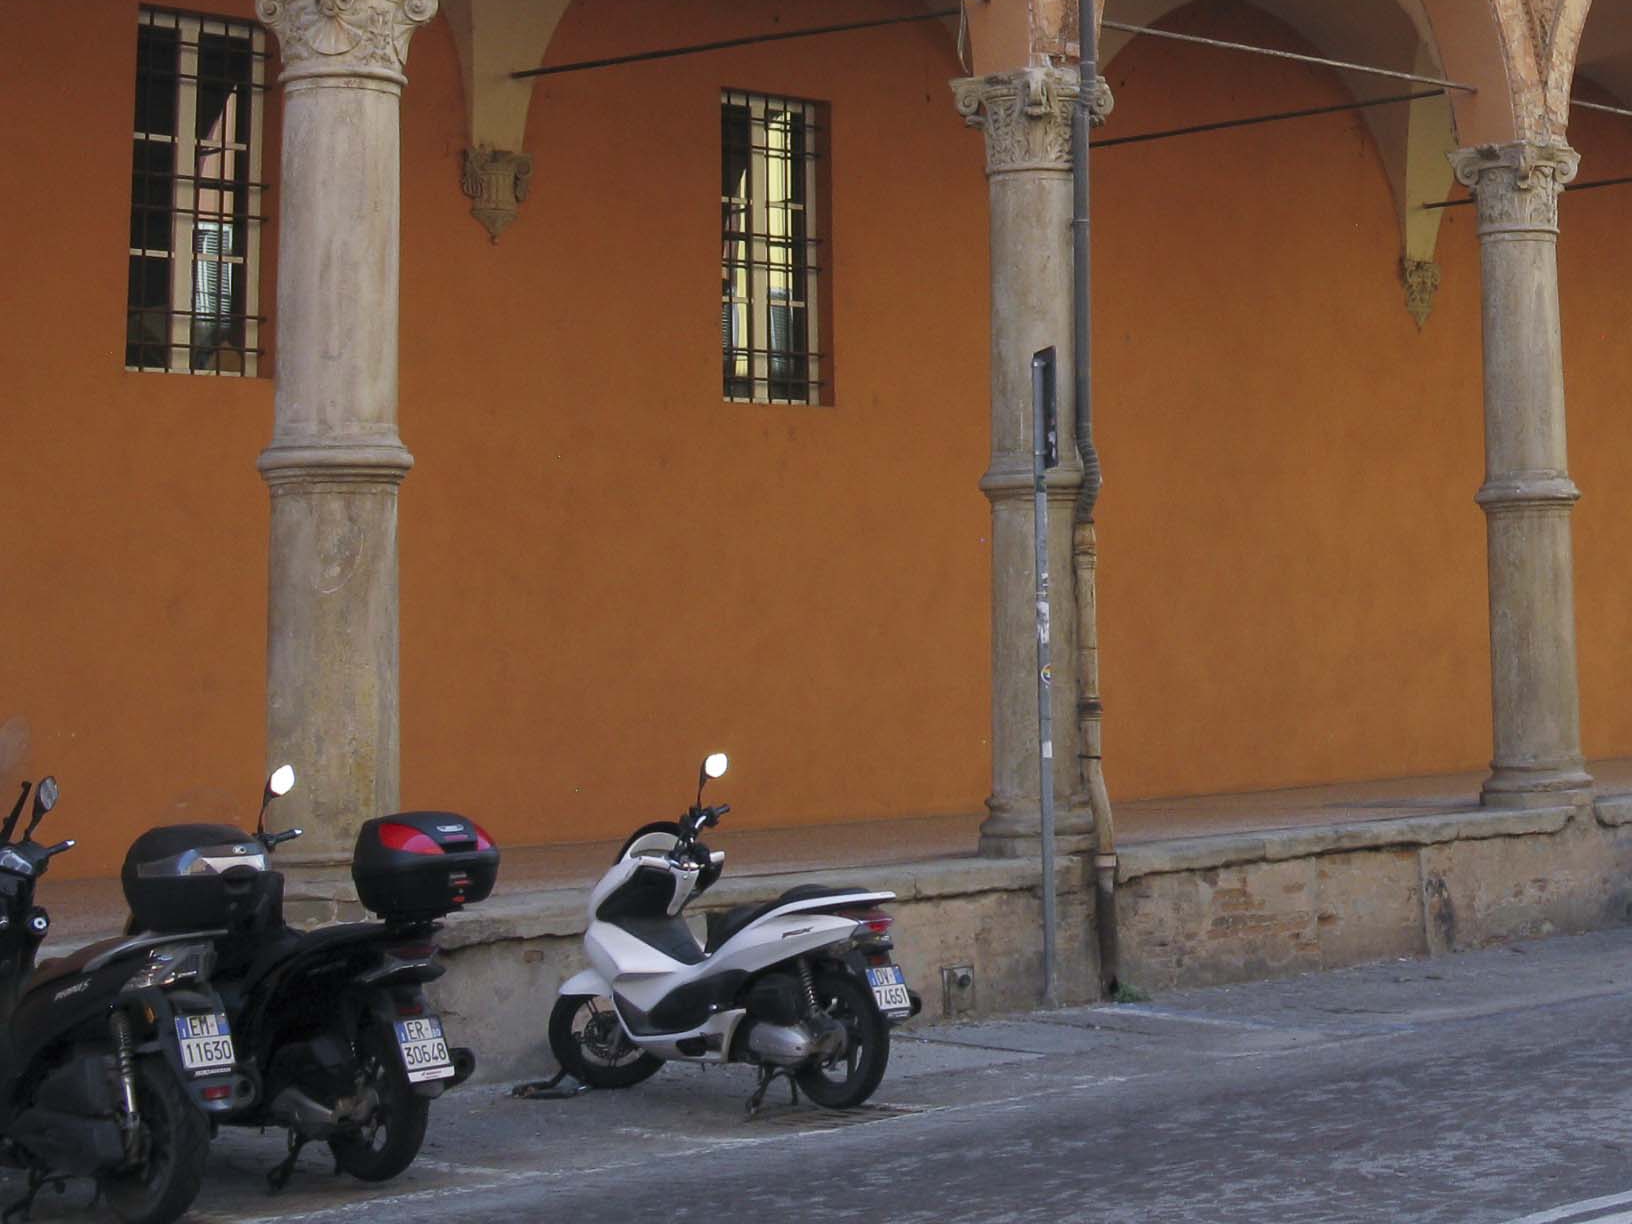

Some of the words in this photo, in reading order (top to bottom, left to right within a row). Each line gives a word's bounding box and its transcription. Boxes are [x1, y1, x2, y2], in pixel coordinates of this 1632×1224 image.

[875, 968, 890, 984] DV
[876, 987, 908, 1006] 74651
[189, 1016, 210, 1036] EM
[406, 1021, 425, 1040] ER
[186, 1040, 232, 1063] 11630
[404, 1042, 447, 1065] 30648
